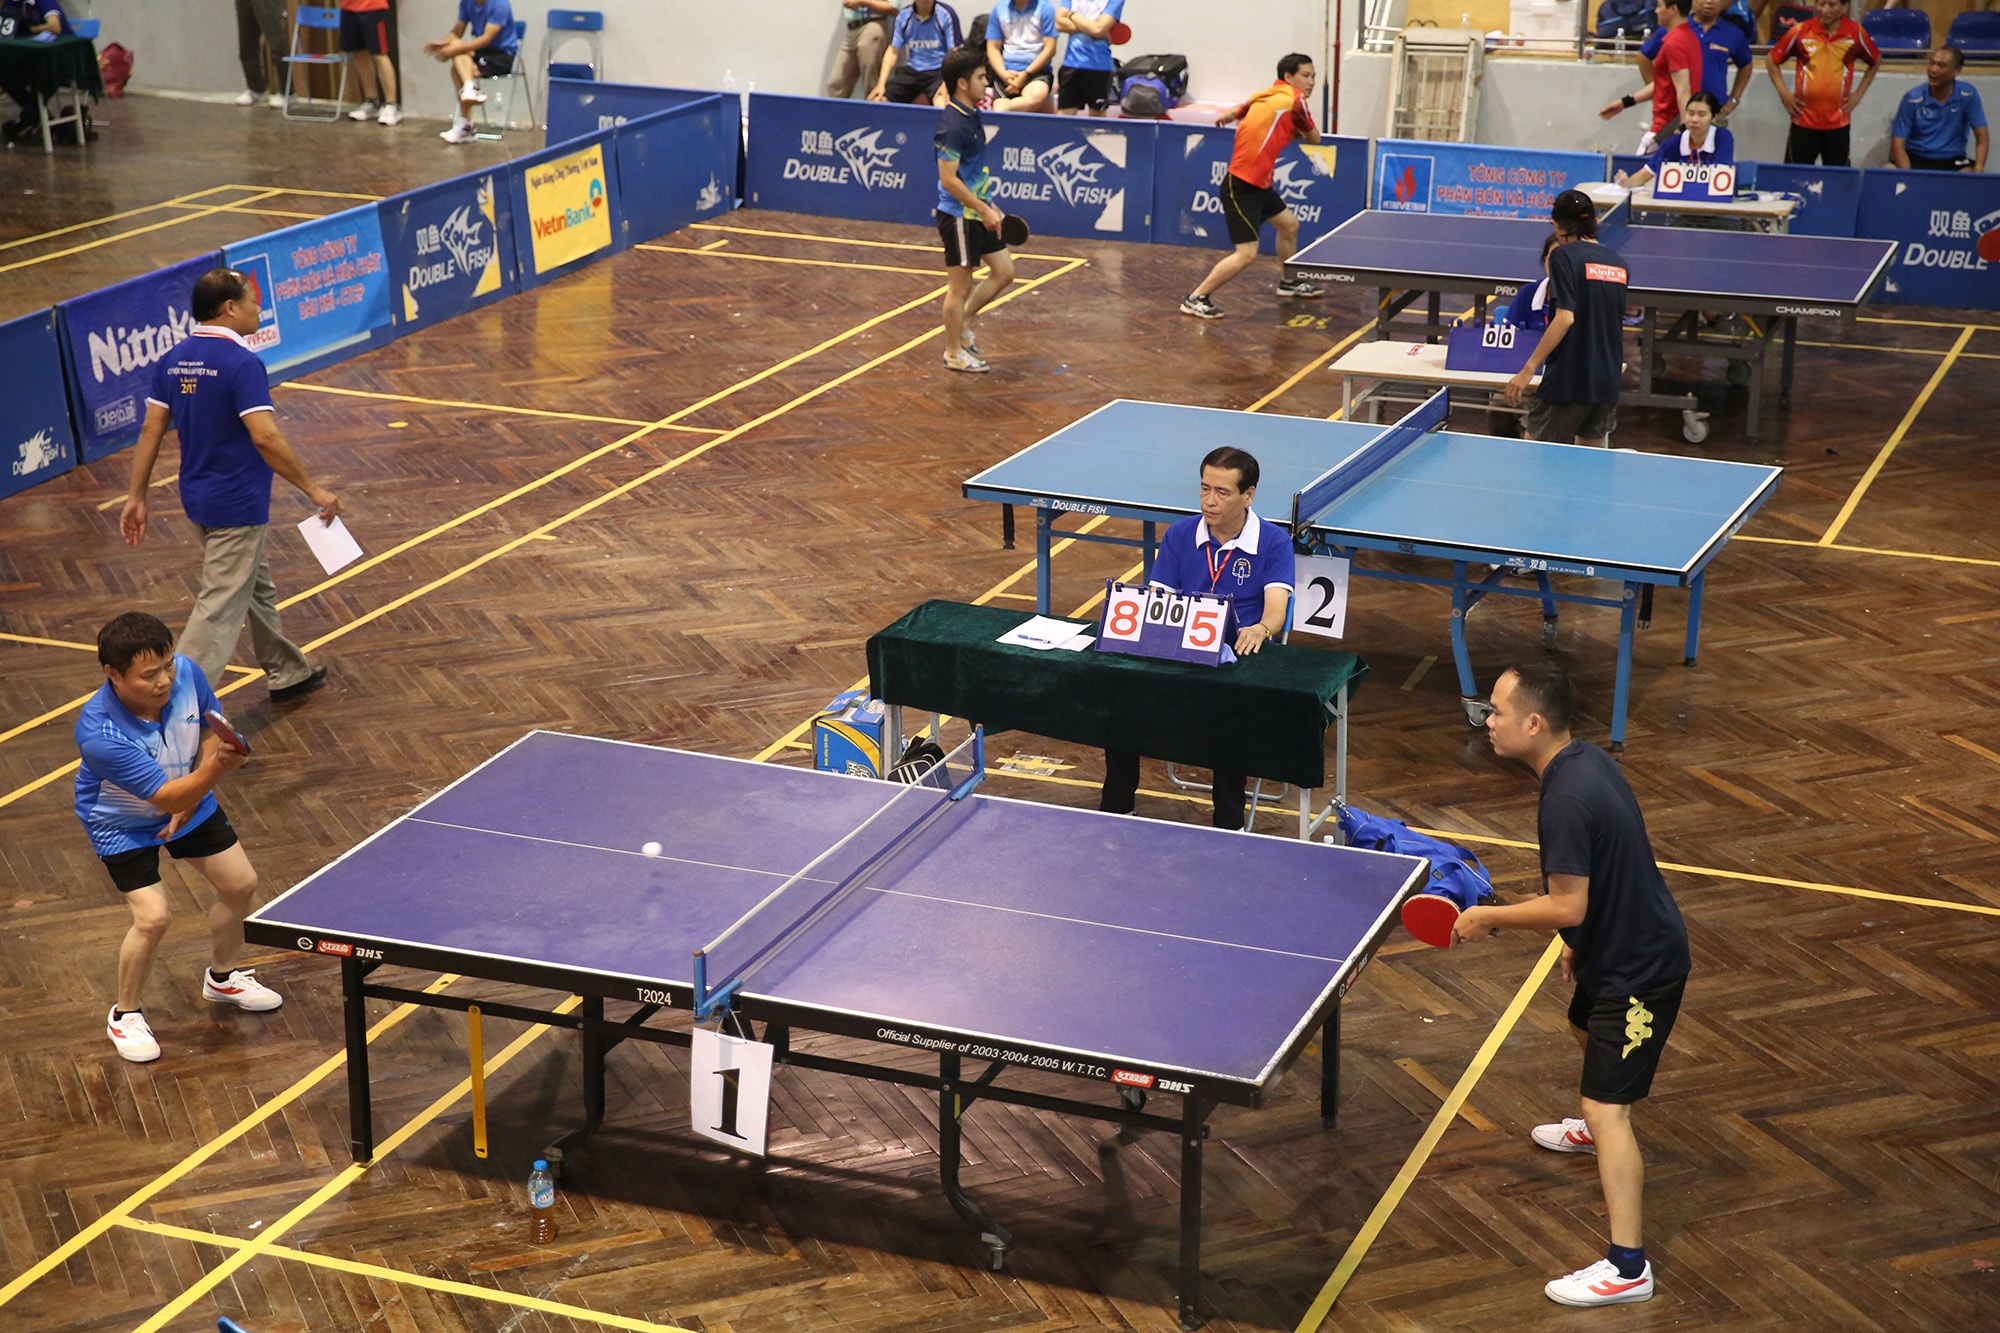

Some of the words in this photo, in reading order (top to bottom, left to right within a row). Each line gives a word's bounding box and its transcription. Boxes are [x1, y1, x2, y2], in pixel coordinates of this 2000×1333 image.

[783, 158, 850, 184] DOUBLE
[870, 170, 907, 189] FISH
[1549, 171, 1567, 187] TY
[988, 176, 1053, 201] DOUBLE
[1074, 186, 1112, 204] FISH
[409, 259, 455, 292] DOUBLE
[468, 246, 492, 272] FISH
[1902, 242, 1988, 271] DOUBLE
[1296, 271, 1355, 282] CHAMPION
[1494, 285, 1518, 296] PRO
[1775, 305, 1841, 317] CHAMPION
[88, 305, 201, 384] Nittak
[1051, 500, 1087, 512] DOUBLE
[1086, 505, 1107, 515] FISH
[1305, 576, 1336, 629] 2
[1110, 601, 1139, 636] 8
[1189, 611, 1218, 647] 5
[356, 947, 384, 960] DHS
[637, 987, 672, 1006] T2024
[876, 1028, 911, 1043] Official
[911, 1034, 957, 1051] Supplier
[957, 1044, 970, 1053] of
[1062, 1060, 1107, 1078] W.T.T.C.
[1157, 1078, 1195, 1094] DHS
[710, 1067, 748, 1141] 1
